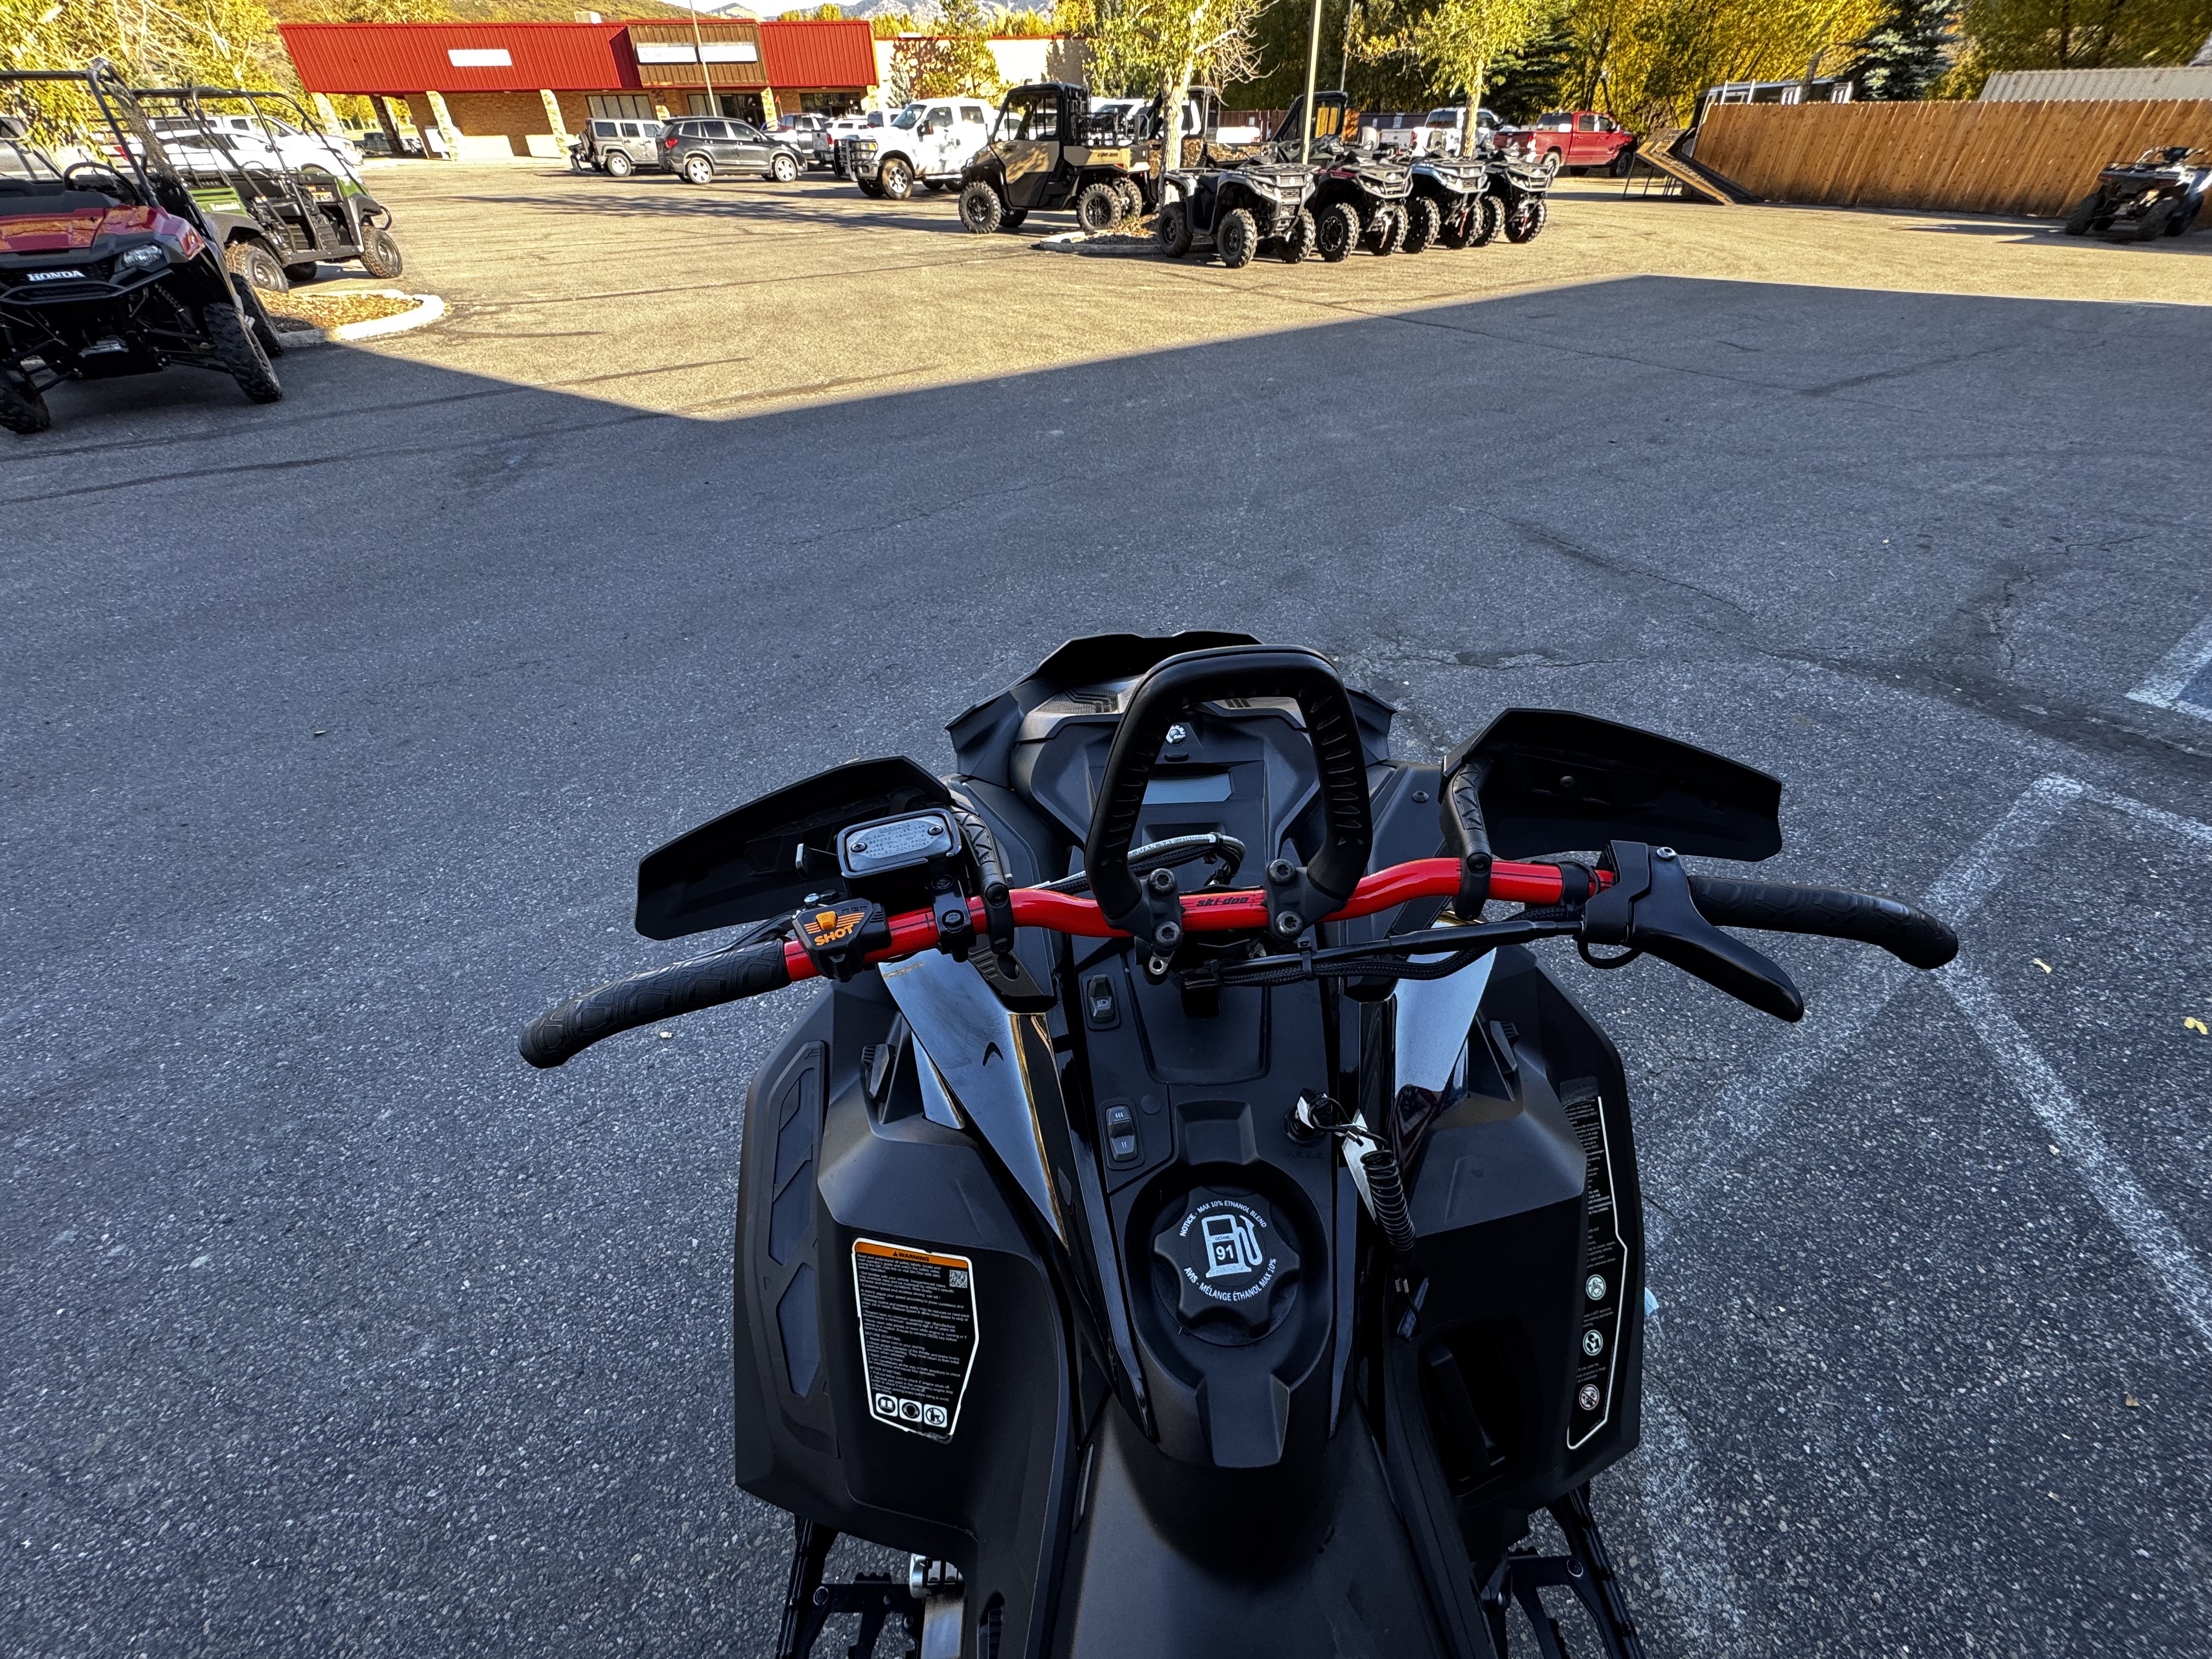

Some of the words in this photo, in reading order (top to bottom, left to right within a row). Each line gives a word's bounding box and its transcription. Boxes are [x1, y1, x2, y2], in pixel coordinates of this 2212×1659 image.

[26, 270, 86, 281] HONDA
[1196, 897, 1249, 906] ski-doo
[814, 924, 854, 946] SHOT
[1180, 1213, 1196, 1238] NOTICE
[1197, 1204, 1211, 1214] MAX
[1224, 1200, 1250, 1214] ETHANOL
[1250, 1210, 1267, 1228] BLEND
[899, 1252, 929, 1262] WARNING
[1216, 1245, 1233, 1260] 91
[1184, 1267, 1198, 1283] AVIS
[1199, 1282, 1232, 1301] MÉLANGE
[1233, 1284, 1262, 1301] ÉTHANOL
[1259, 1272, 1272, 1288] MAX
[1267, 1257, 1277, 1274] 10%
